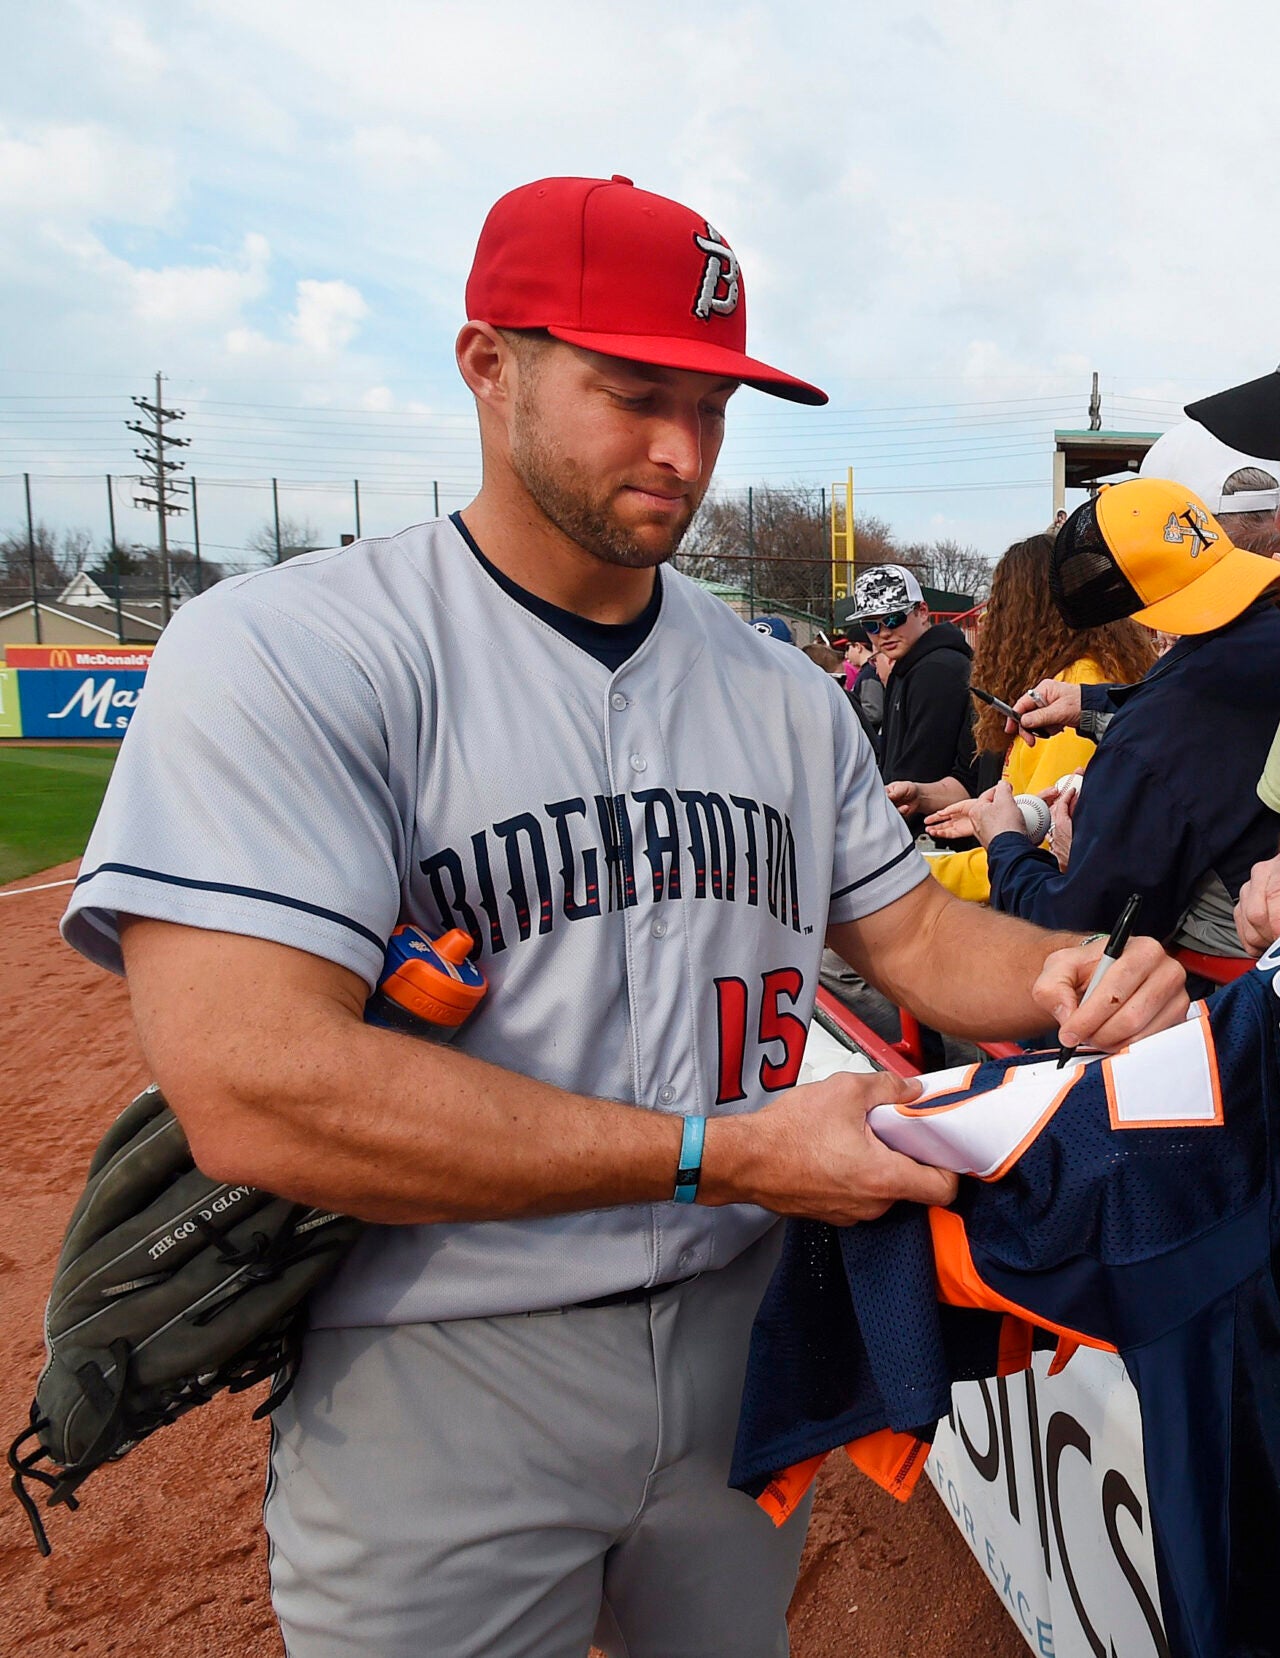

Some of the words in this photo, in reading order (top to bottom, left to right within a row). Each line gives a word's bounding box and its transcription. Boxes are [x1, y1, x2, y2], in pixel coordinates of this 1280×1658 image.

[419, 787, 801, 961] BINGHAMTON
[713, 966, 807, 1106] 15
[148, 1233, 176, 1260] THE
[174, 1208, 213, 1241] GOD
[212, 1182, 256, 1213] GLOV
[936, 1459, 978, 1547] FOR
